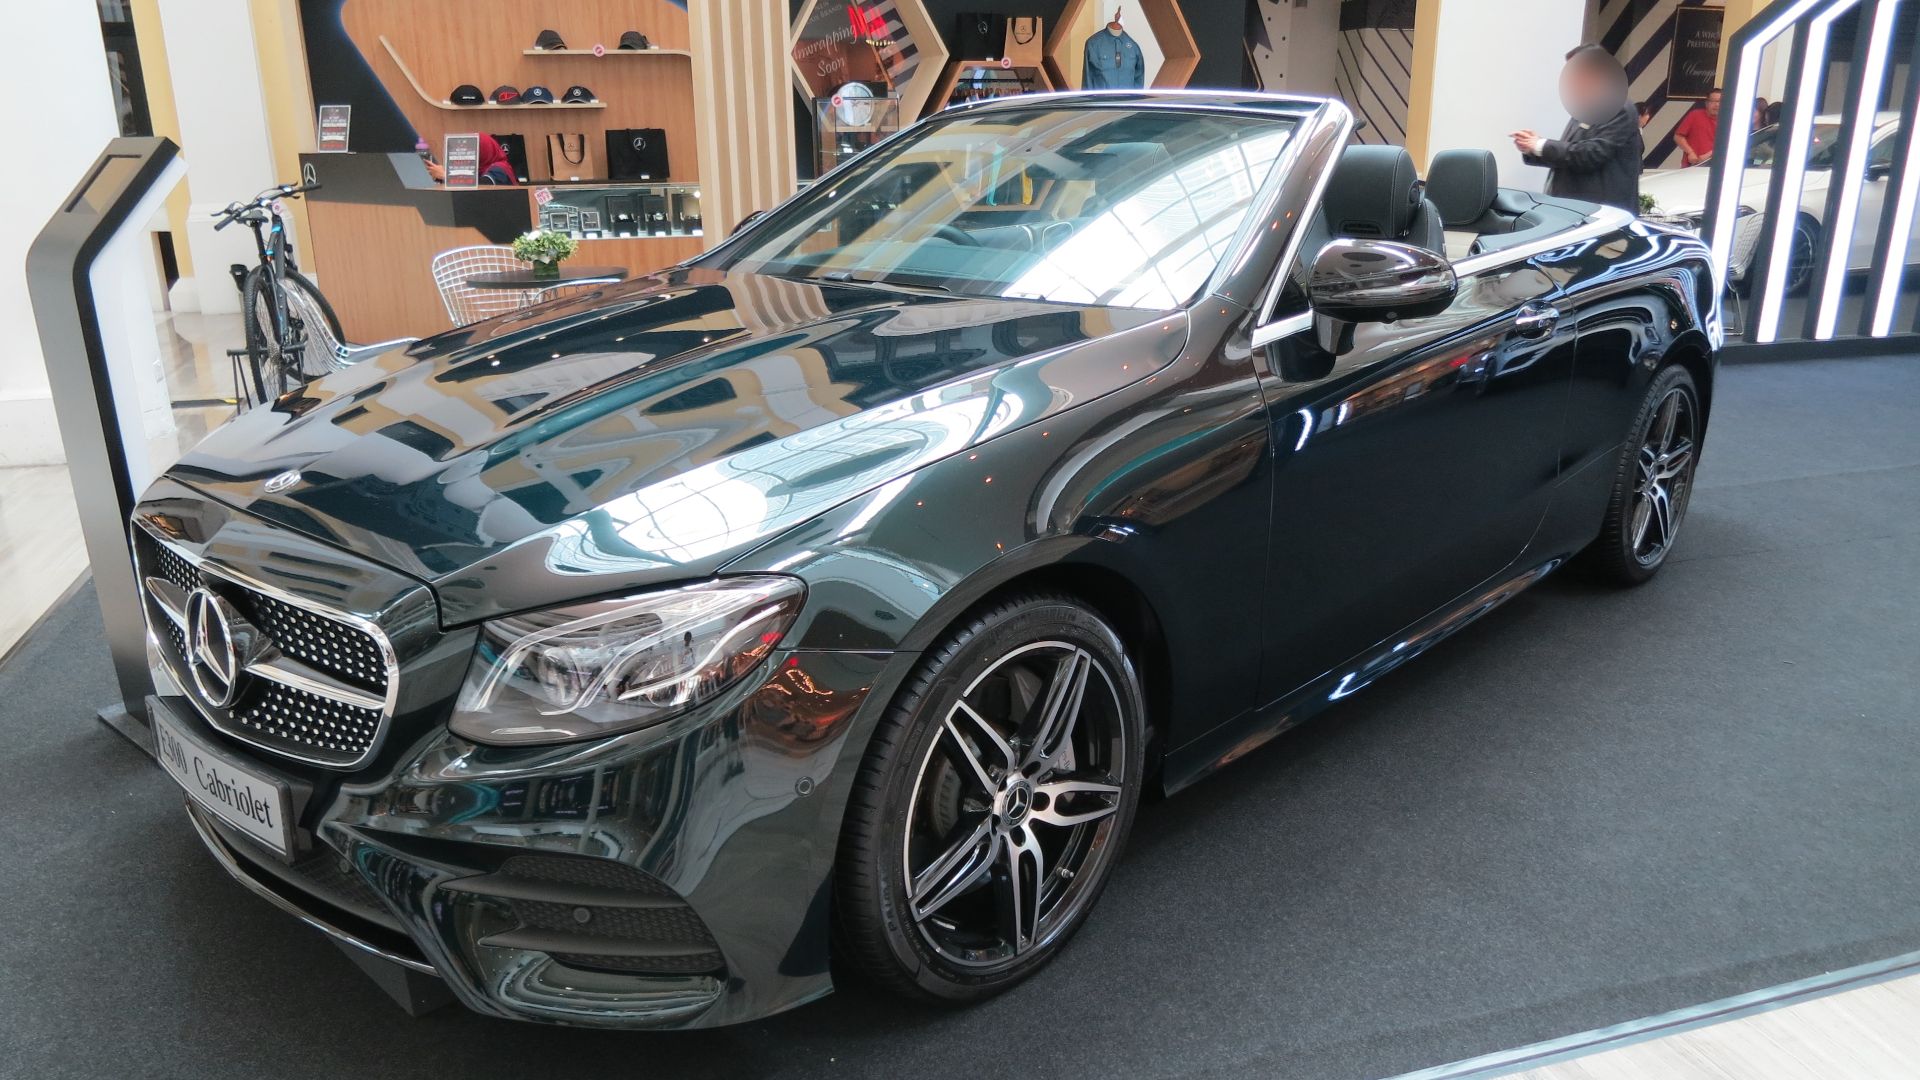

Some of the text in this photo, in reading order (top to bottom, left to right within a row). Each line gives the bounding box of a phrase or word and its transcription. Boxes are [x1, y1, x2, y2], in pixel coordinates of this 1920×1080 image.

[816, 57, 845, 77] Soon
[158, 723, 273, 829] E300 Cabriolet
